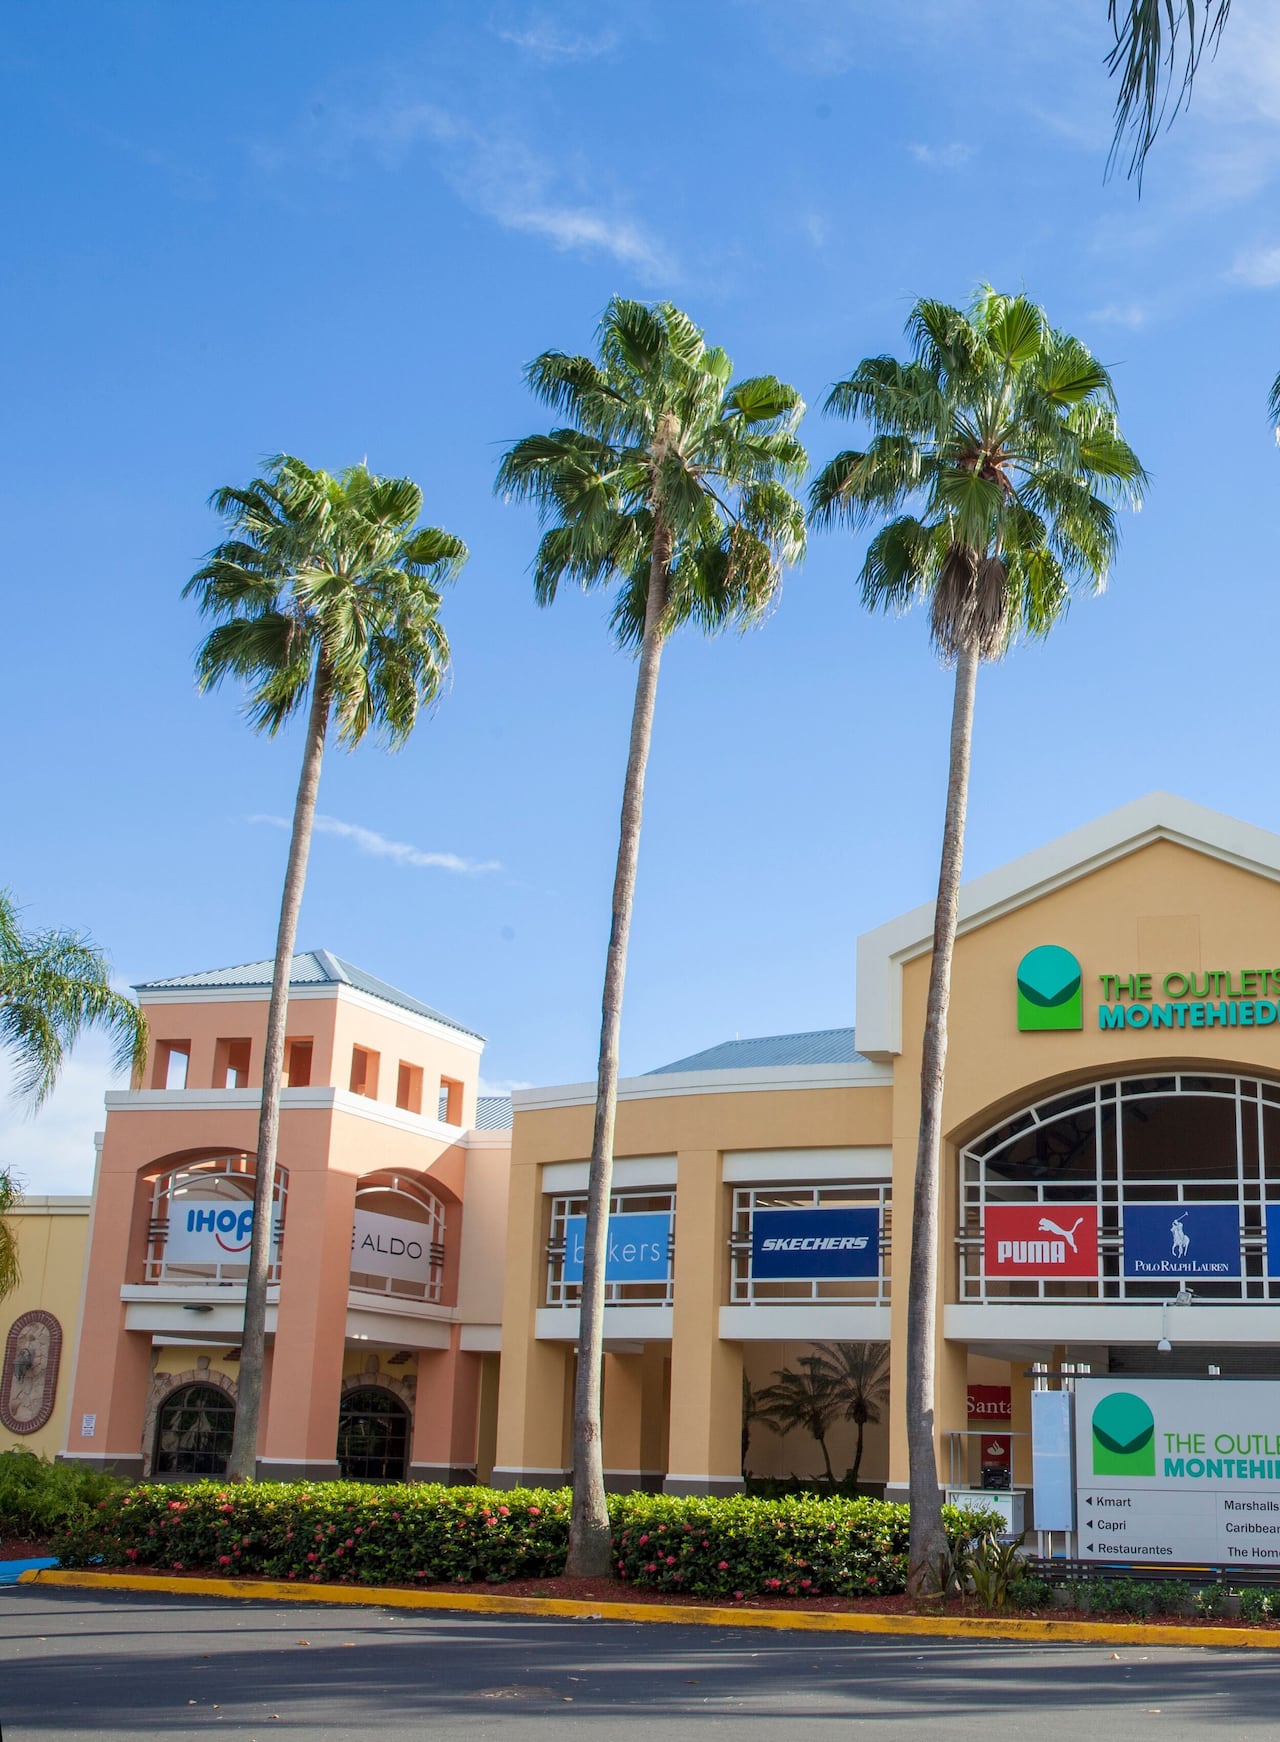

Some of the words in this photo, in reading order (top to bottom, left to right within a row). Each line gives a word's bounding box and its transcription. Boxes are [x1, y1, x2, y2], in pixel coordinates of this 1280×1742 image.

[1099, 973, 1152, 1001] THE
[360, 1233, 423, 1260] ALDO
[573, 1232, 661, 1264] bkers
[761, 1236, 869, 1252] SKECHERS
[997, 1240, 1066, 1265] PUMA
[1163, 1433, 1206, 1454] THE
[1096, 1496, 1132, 1508] Kmart
[1224, 1500, 1280, 1512] Marshalls
[1097, 1520, 1127, 1532] Capri
[1098, 1543, 1173, 1556] Restaurantes
[1227, 1546, 1248, 1558] The
